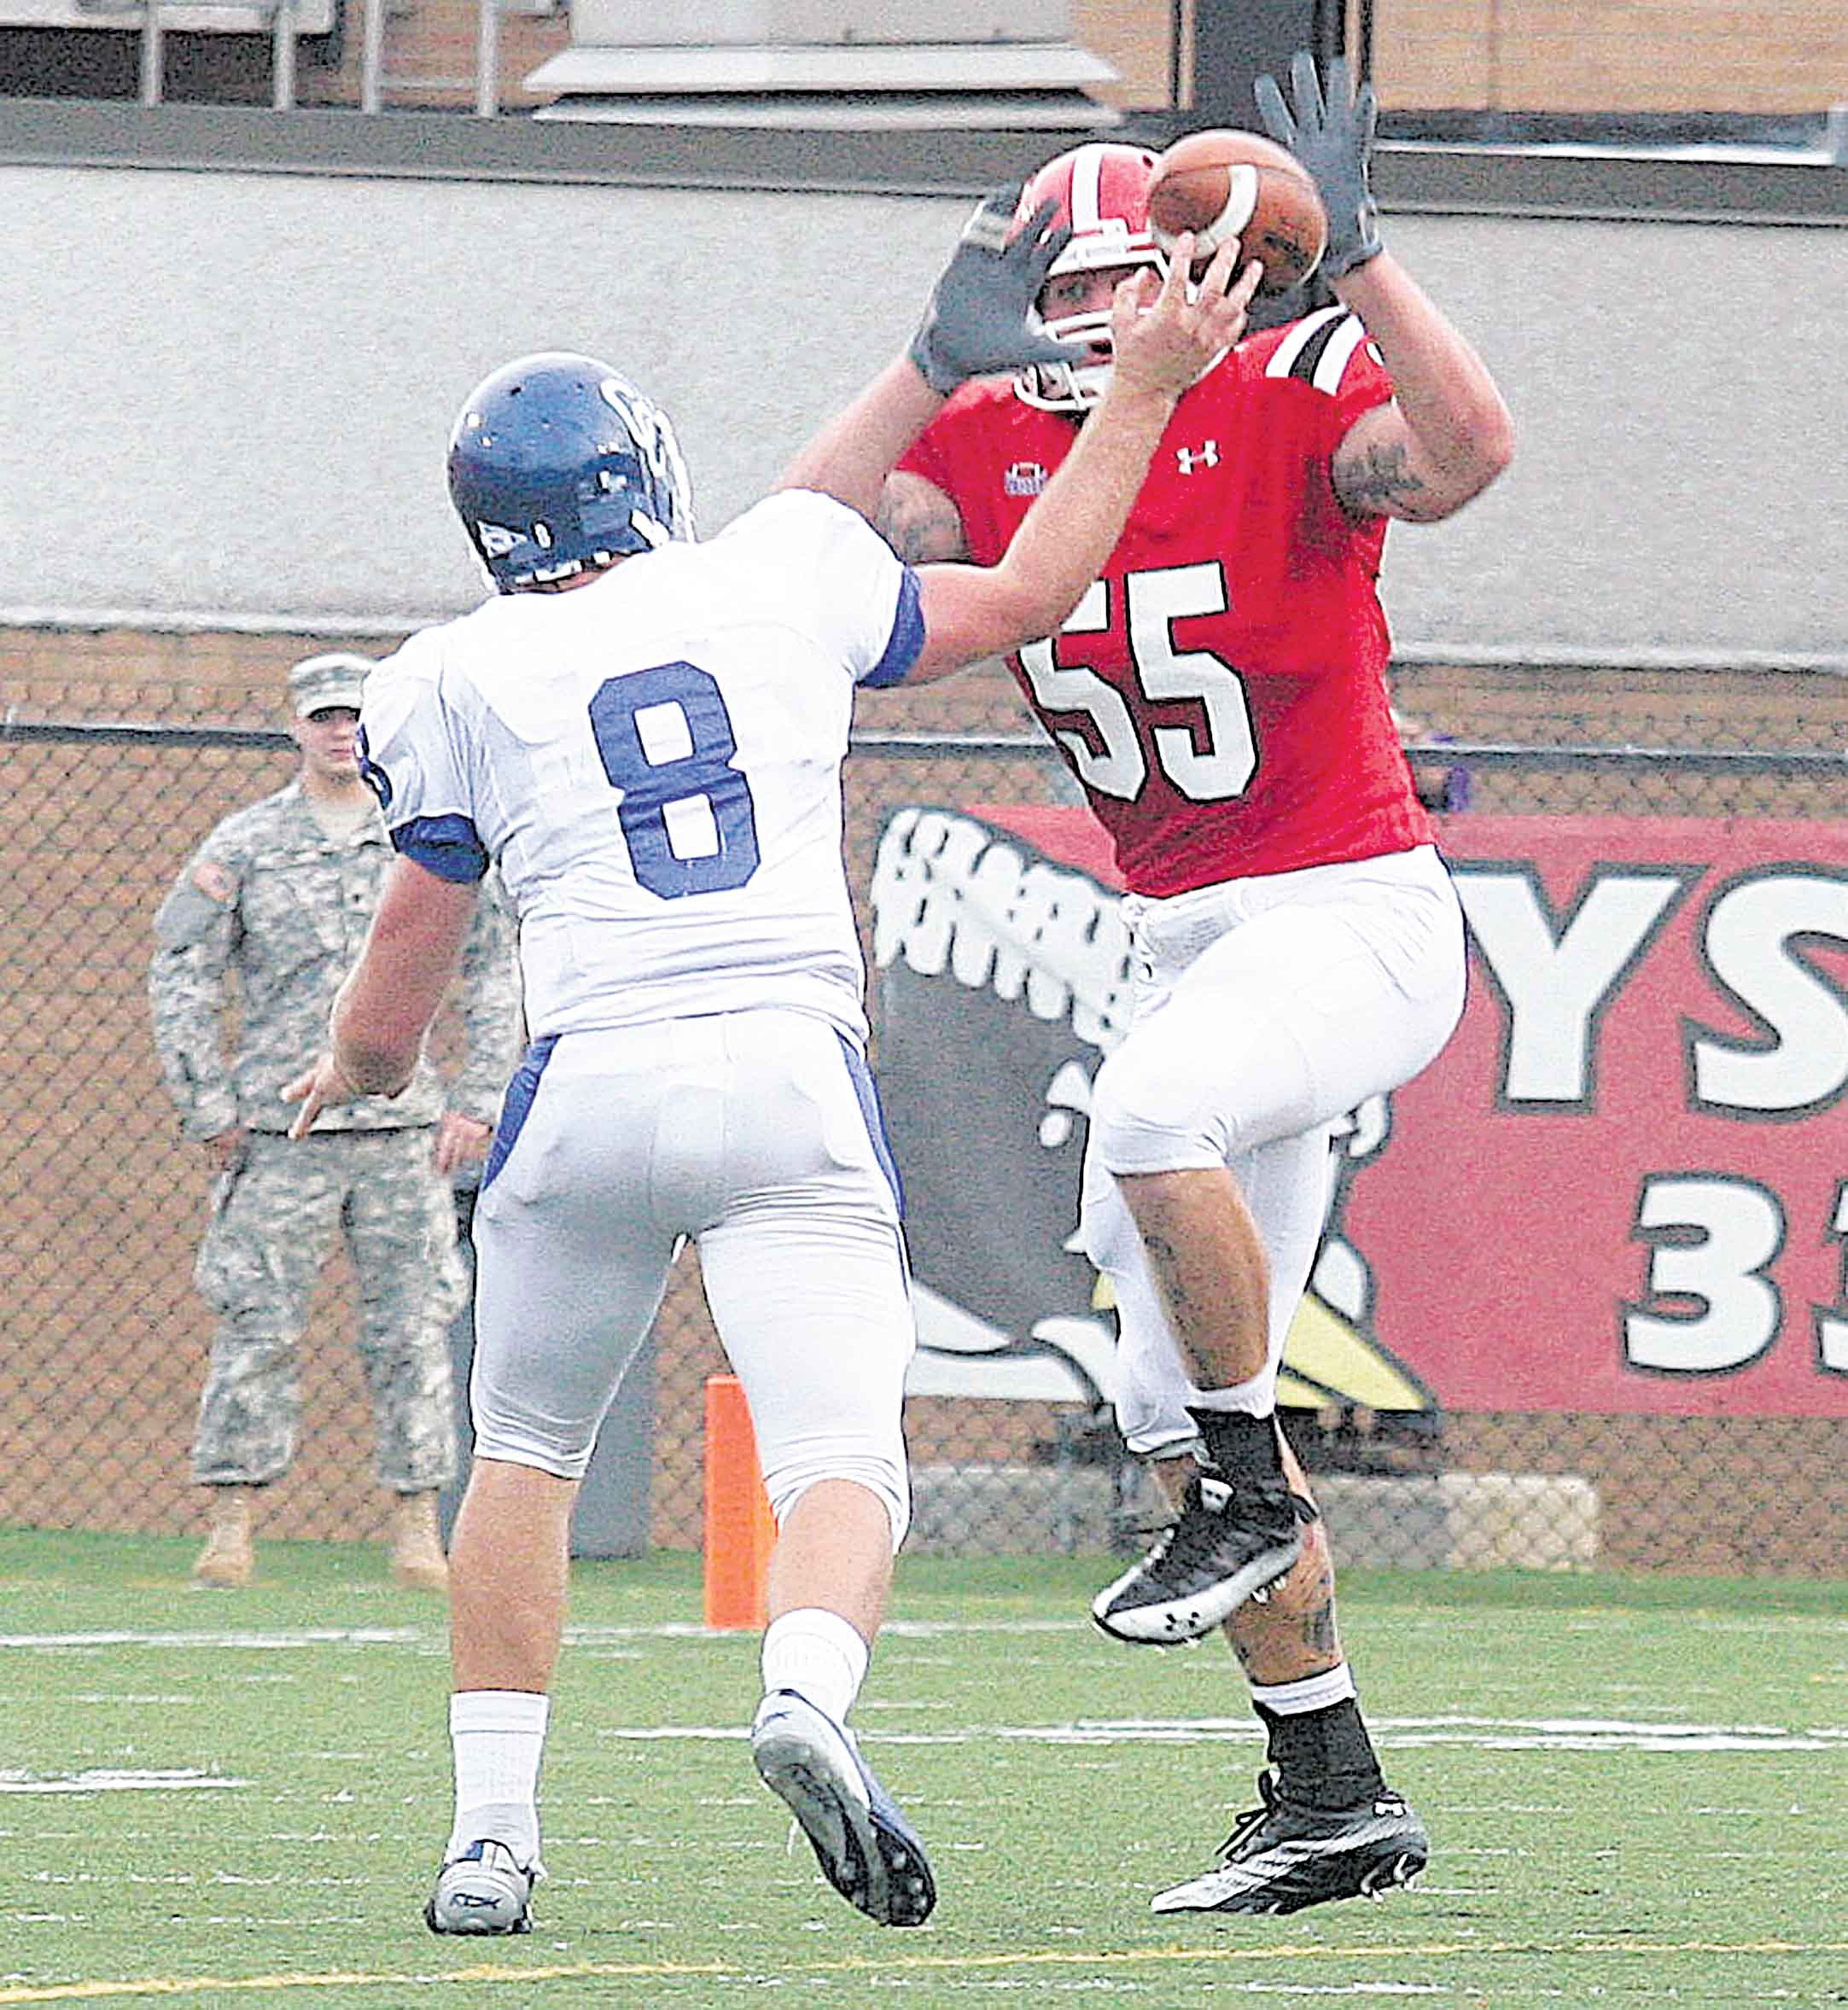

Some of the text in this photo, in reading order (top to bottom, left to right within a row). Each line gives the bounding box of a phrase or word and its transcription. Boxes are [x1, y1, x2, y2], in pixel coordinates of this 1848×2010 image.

[588, 661, 761, 900] 8
[1017, 561, 1260, 803] 55
[1618, 1171, 1848, 1378] 3
